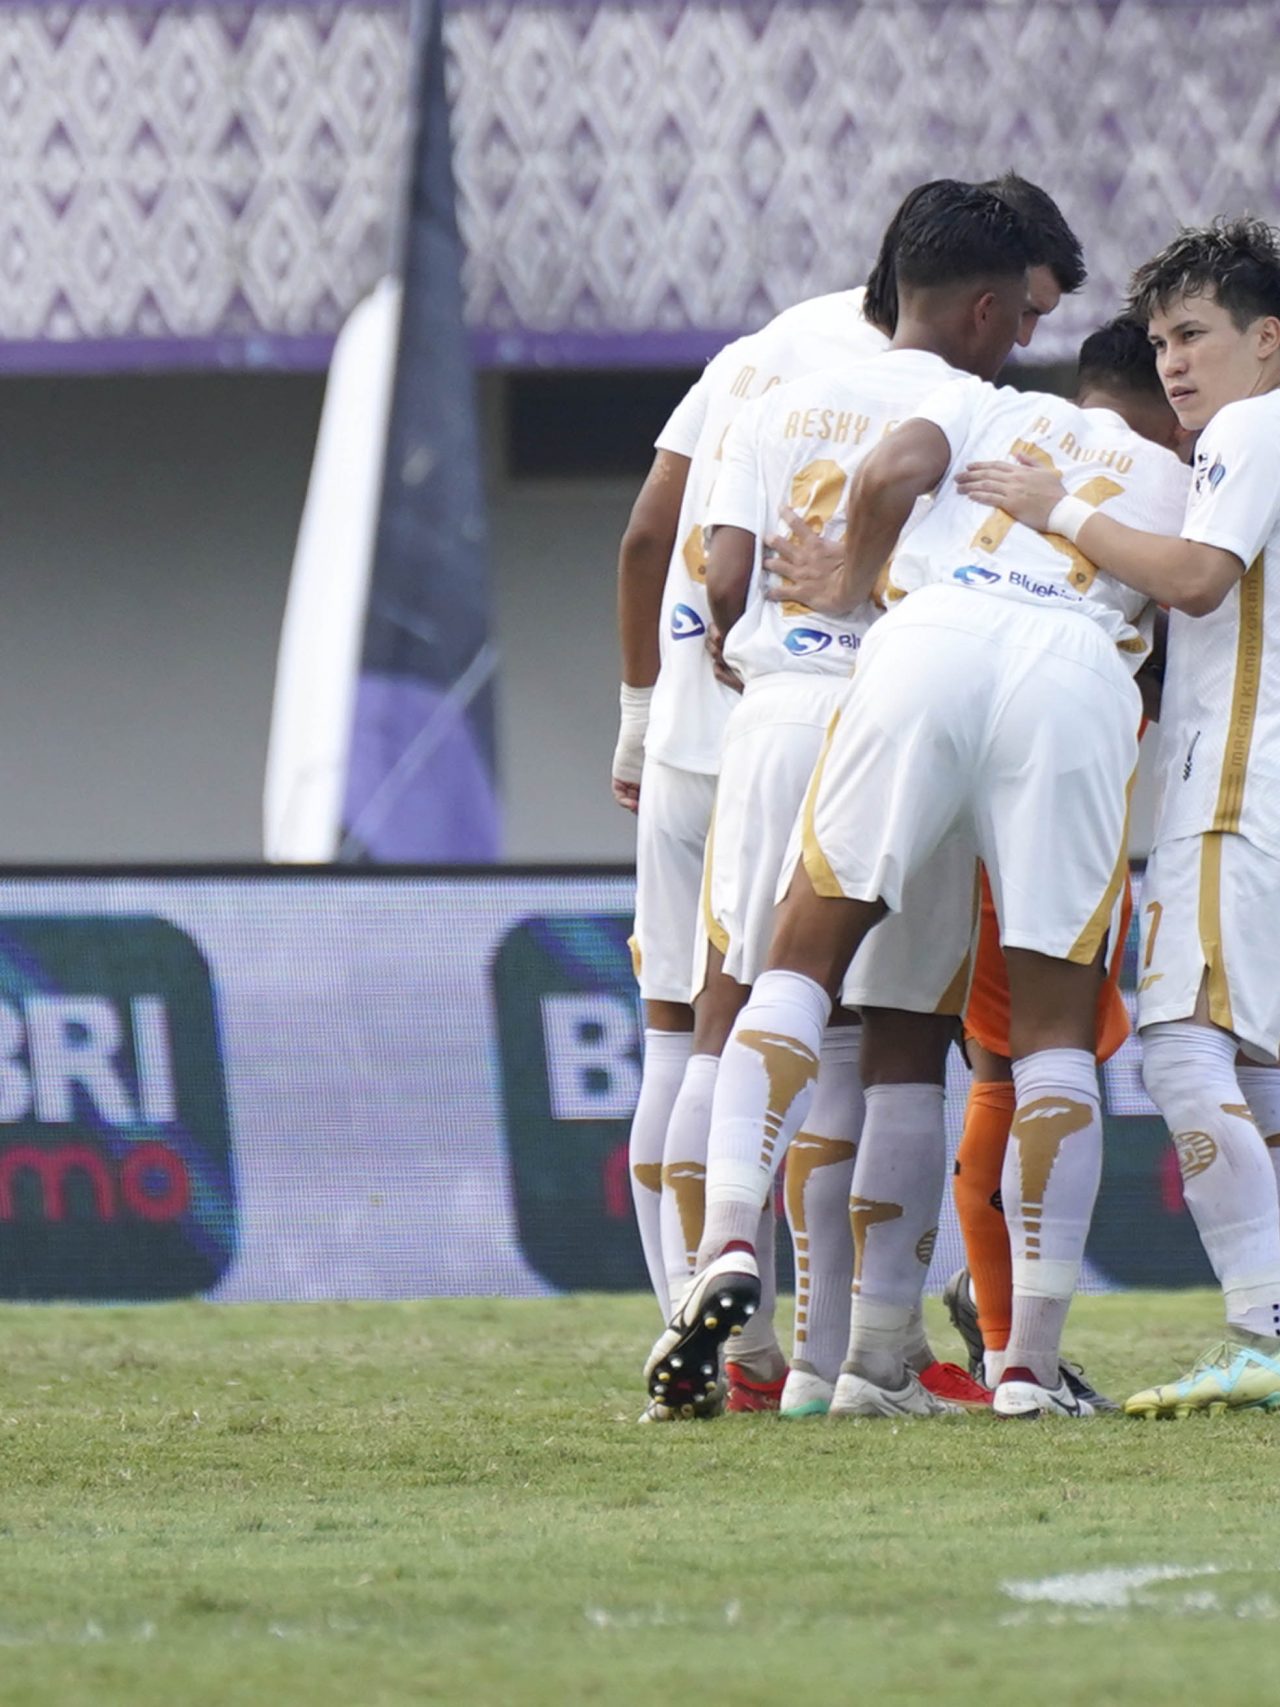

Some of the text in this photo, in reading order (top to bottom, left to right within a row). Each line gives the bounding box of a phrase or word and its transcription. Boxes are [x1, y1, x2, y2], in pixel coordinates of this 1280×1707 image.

[784, 408, 870, 444] RESKY
[1231, 579, 1259, 767] MACAN KEMAYORAN
